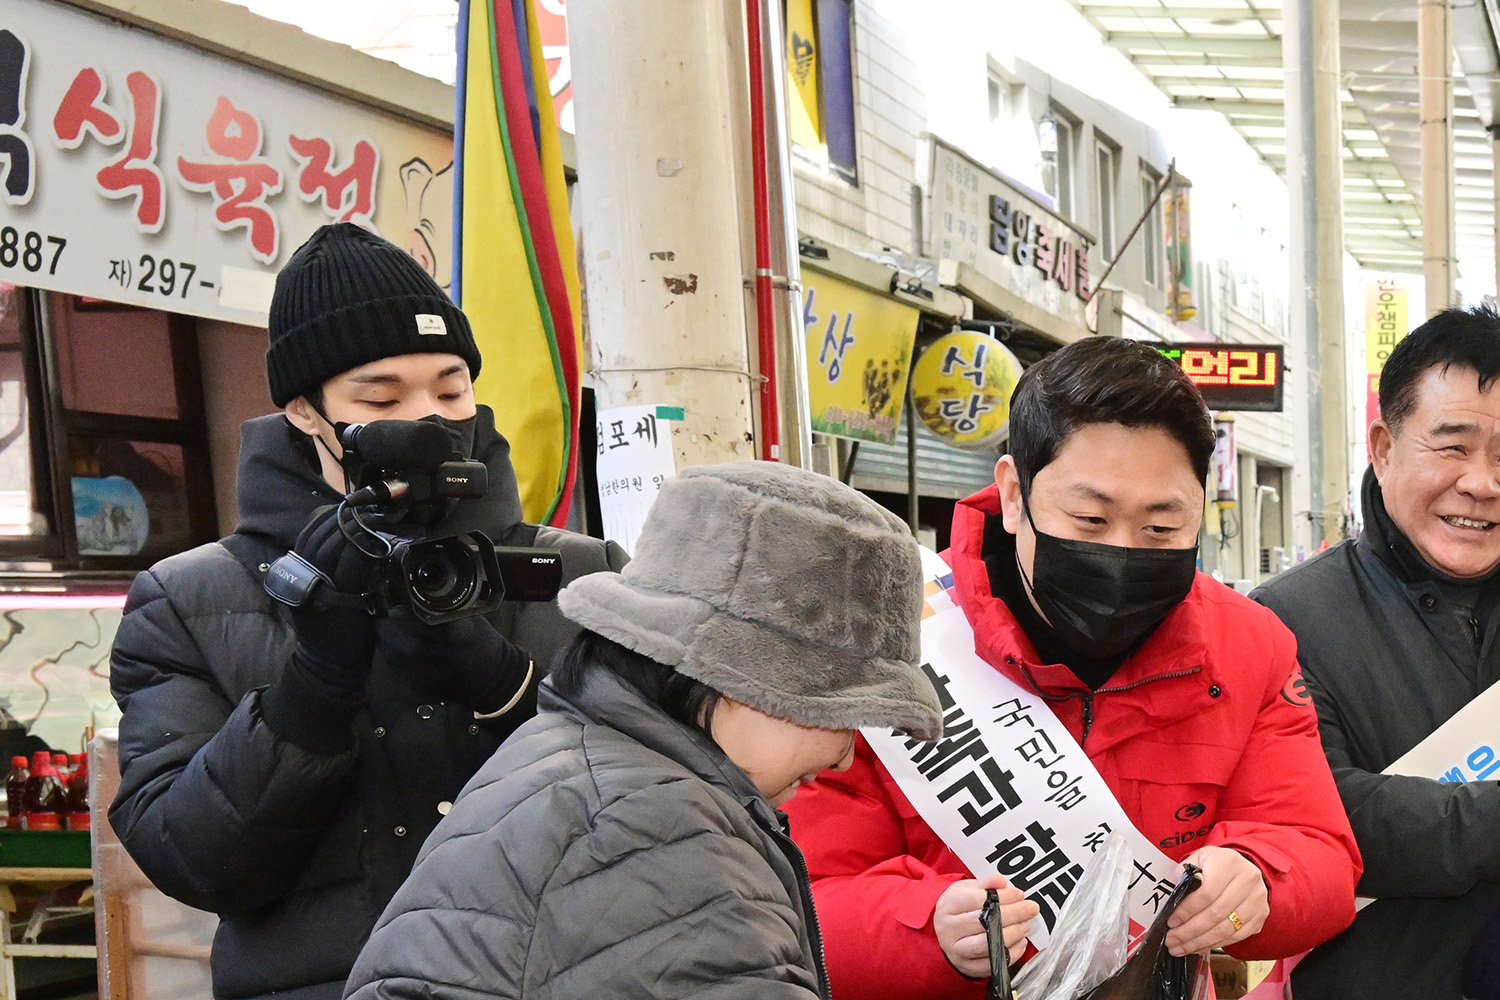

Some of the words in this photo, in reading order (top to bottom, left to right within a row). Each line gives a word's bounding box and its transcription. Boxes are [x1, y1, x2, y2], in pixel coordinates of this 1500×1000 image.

[941, 343, 990, 433] 식당
[444, 476, 469, 484] SONY
[530, 557, 556, 565] SONY
[273, 565, 298, 586] SONY
[992, 697, 1088, 812] 국민을
